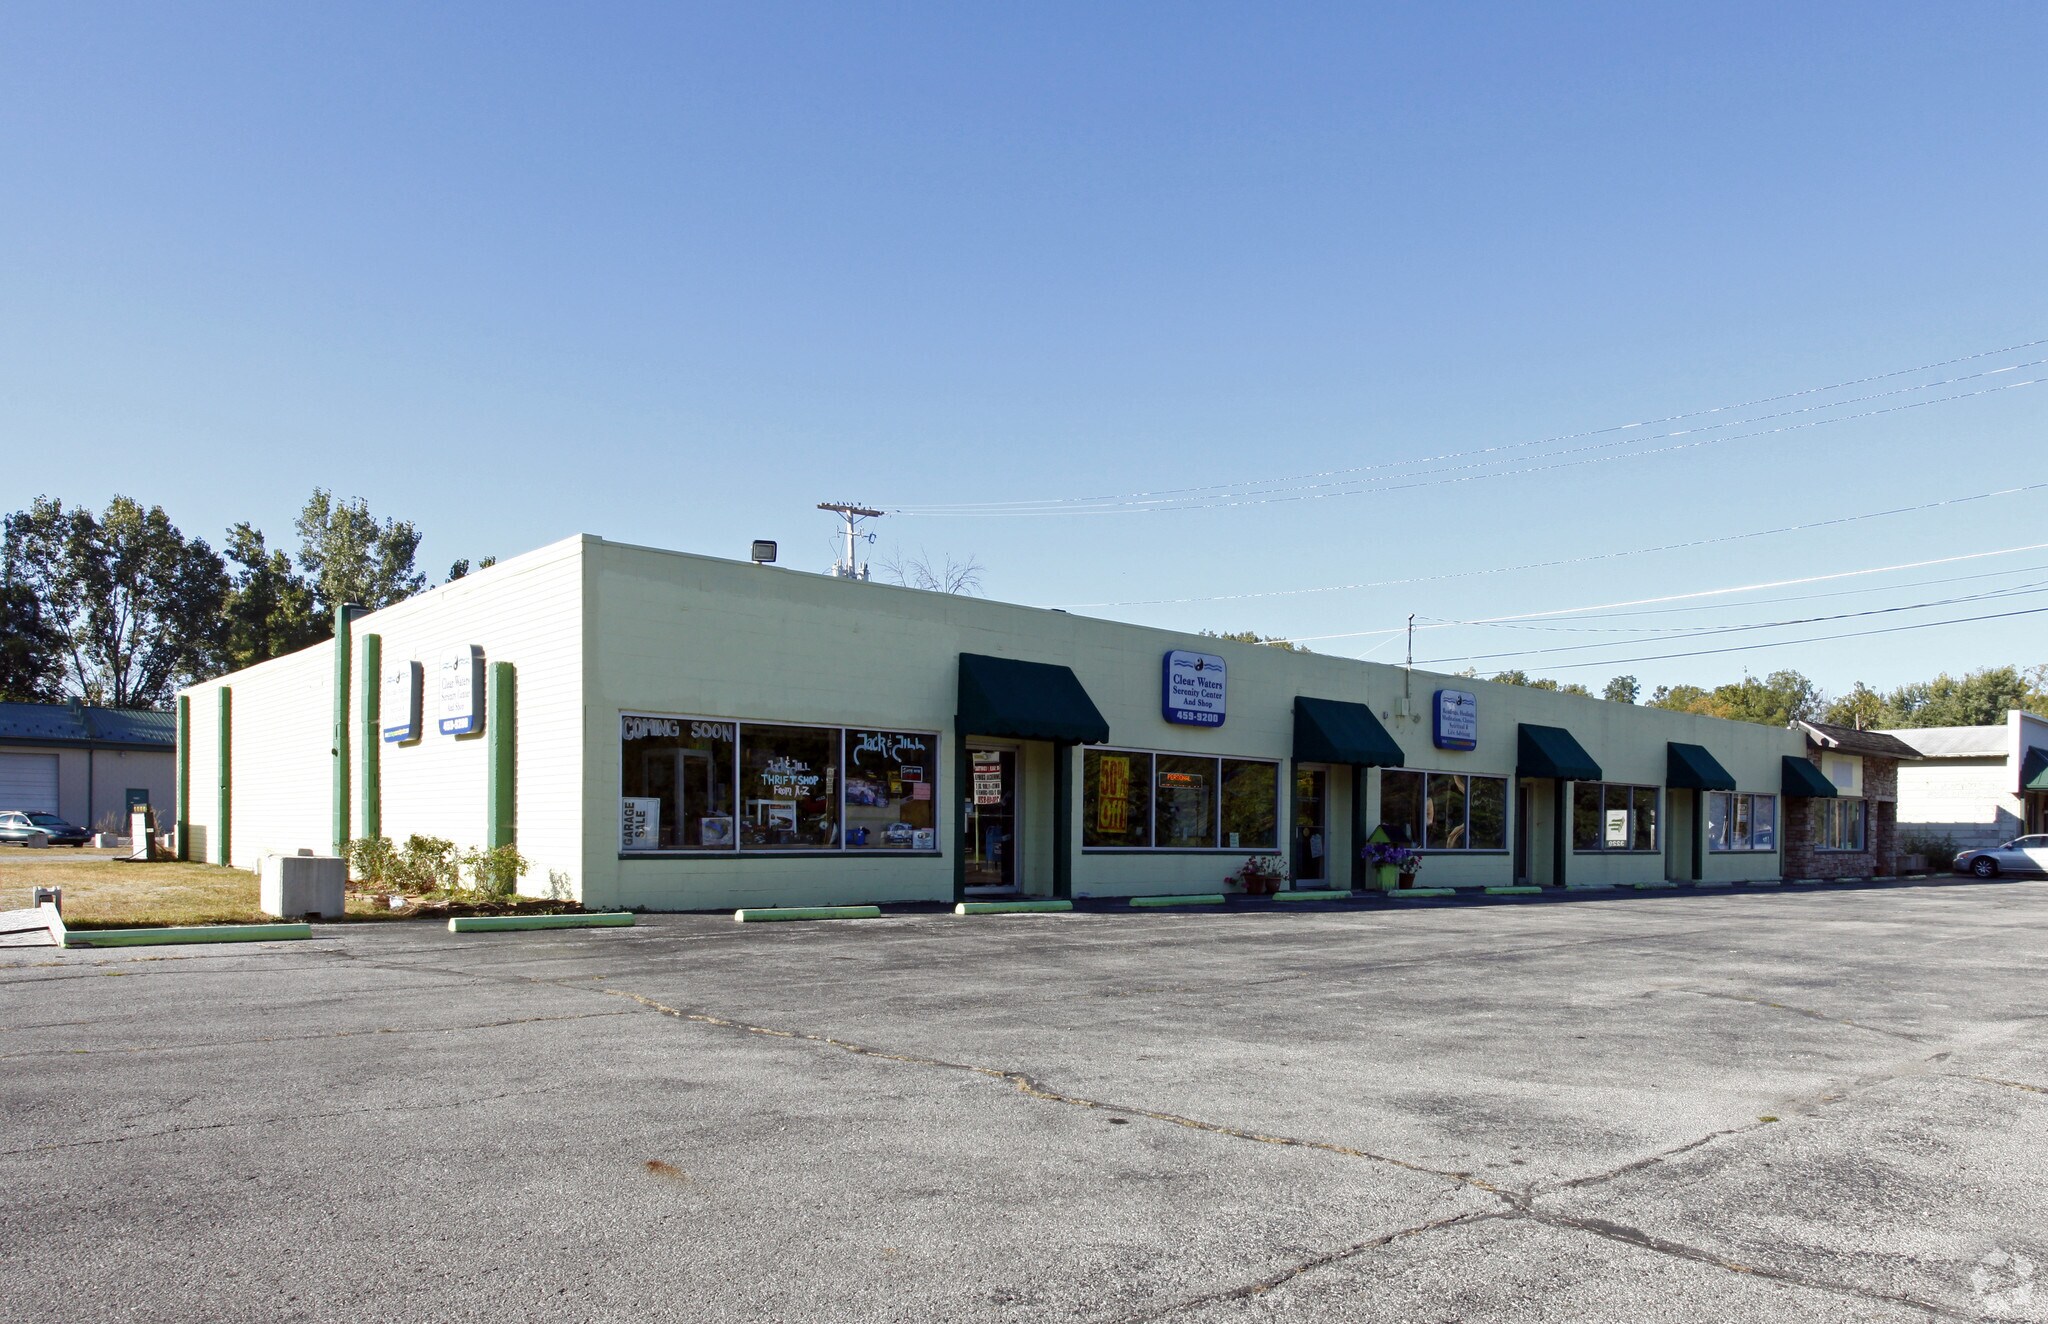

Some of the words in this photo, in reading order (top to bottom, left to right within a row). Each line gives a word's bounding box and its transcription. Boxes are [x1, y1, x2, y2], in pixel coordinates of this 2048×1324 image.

[1173, 673, 1195, 686] Clear
[1197, 676, 1222, 690] Waters
[1173, 685, 1199, 698] Serenity
[1201, 689, 1222, 700] Center
[1183, 697, 1196, 706] And
[1198, 699, 1212, 709] Shop
[1176, 710, 1218, 723] 459-9200
[622, 717, 680, 740] COMING
[690, 721, 734, 742] SOON
[761, 773, 797, 785] THRIFT
[797, 775, 820, 786] SHOP
[1101, 760, 1128, 797] 50%
[624, 802, 635, 846] GARAGE
[636, 811, 646, 838] SALE
[1101, 799, 1127, 829] Off!
